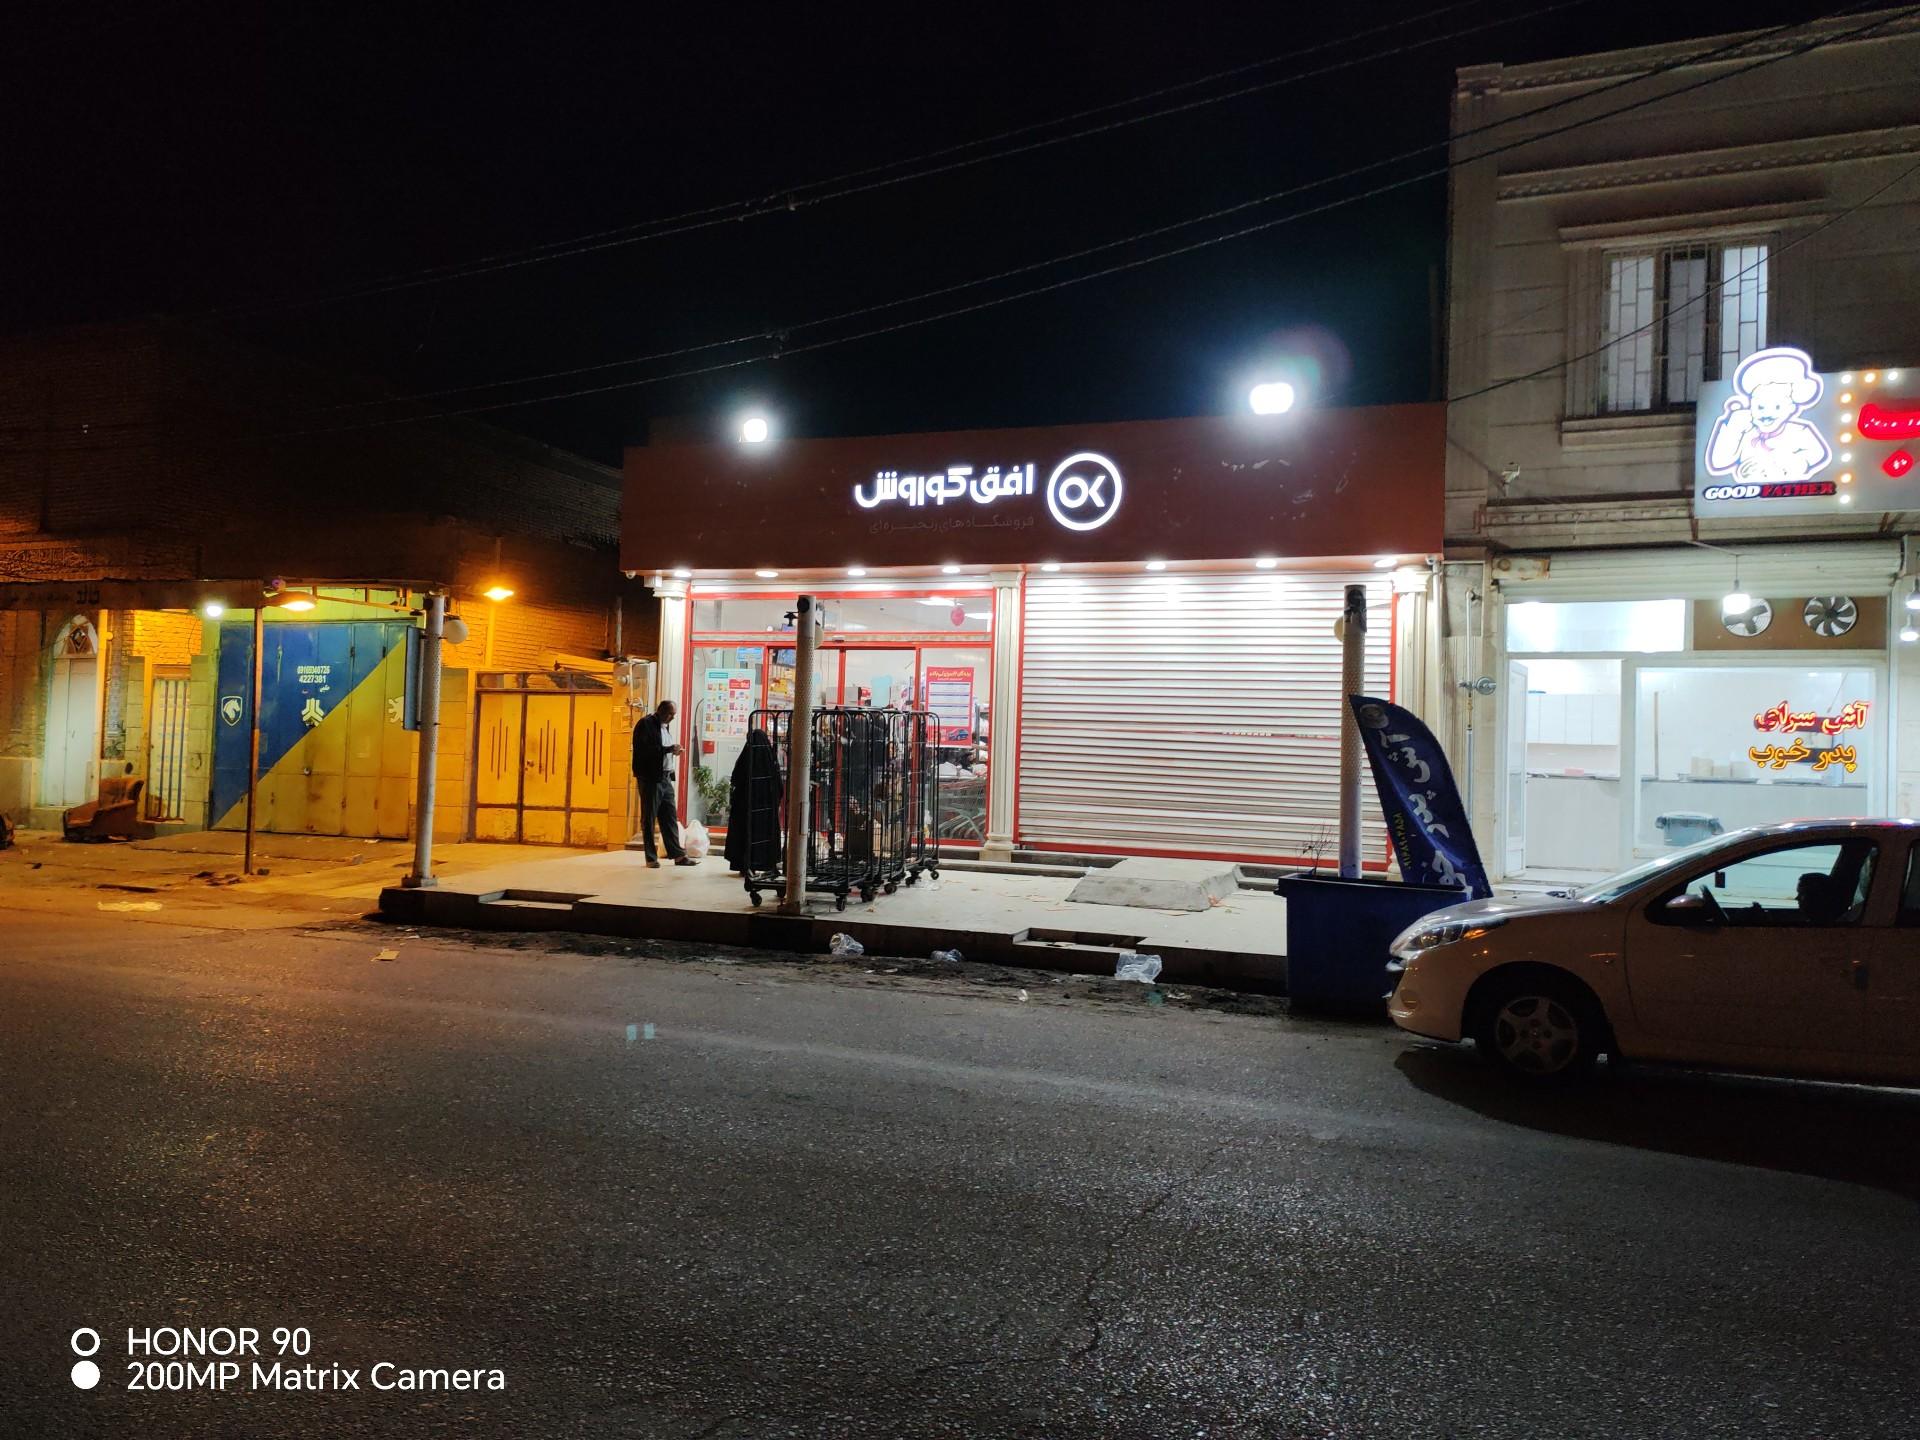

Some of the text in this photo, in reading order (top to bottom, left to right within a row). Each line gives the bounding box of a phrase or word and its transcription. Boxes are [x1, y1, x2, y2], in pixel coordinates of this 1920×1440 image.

[855, 463, 1034, 508] افق کوروش
[1058, 475, 1106, 508] OK
[1704, 482, 1835, 500] GOOD FATHER
[1754, 700, 1871, 735] آش سرای
[1749, 738, 1856, 772] پدر خوب
[1379, 730, 1431, 783] آش
[1408, 790, 1450, 838] پدر
